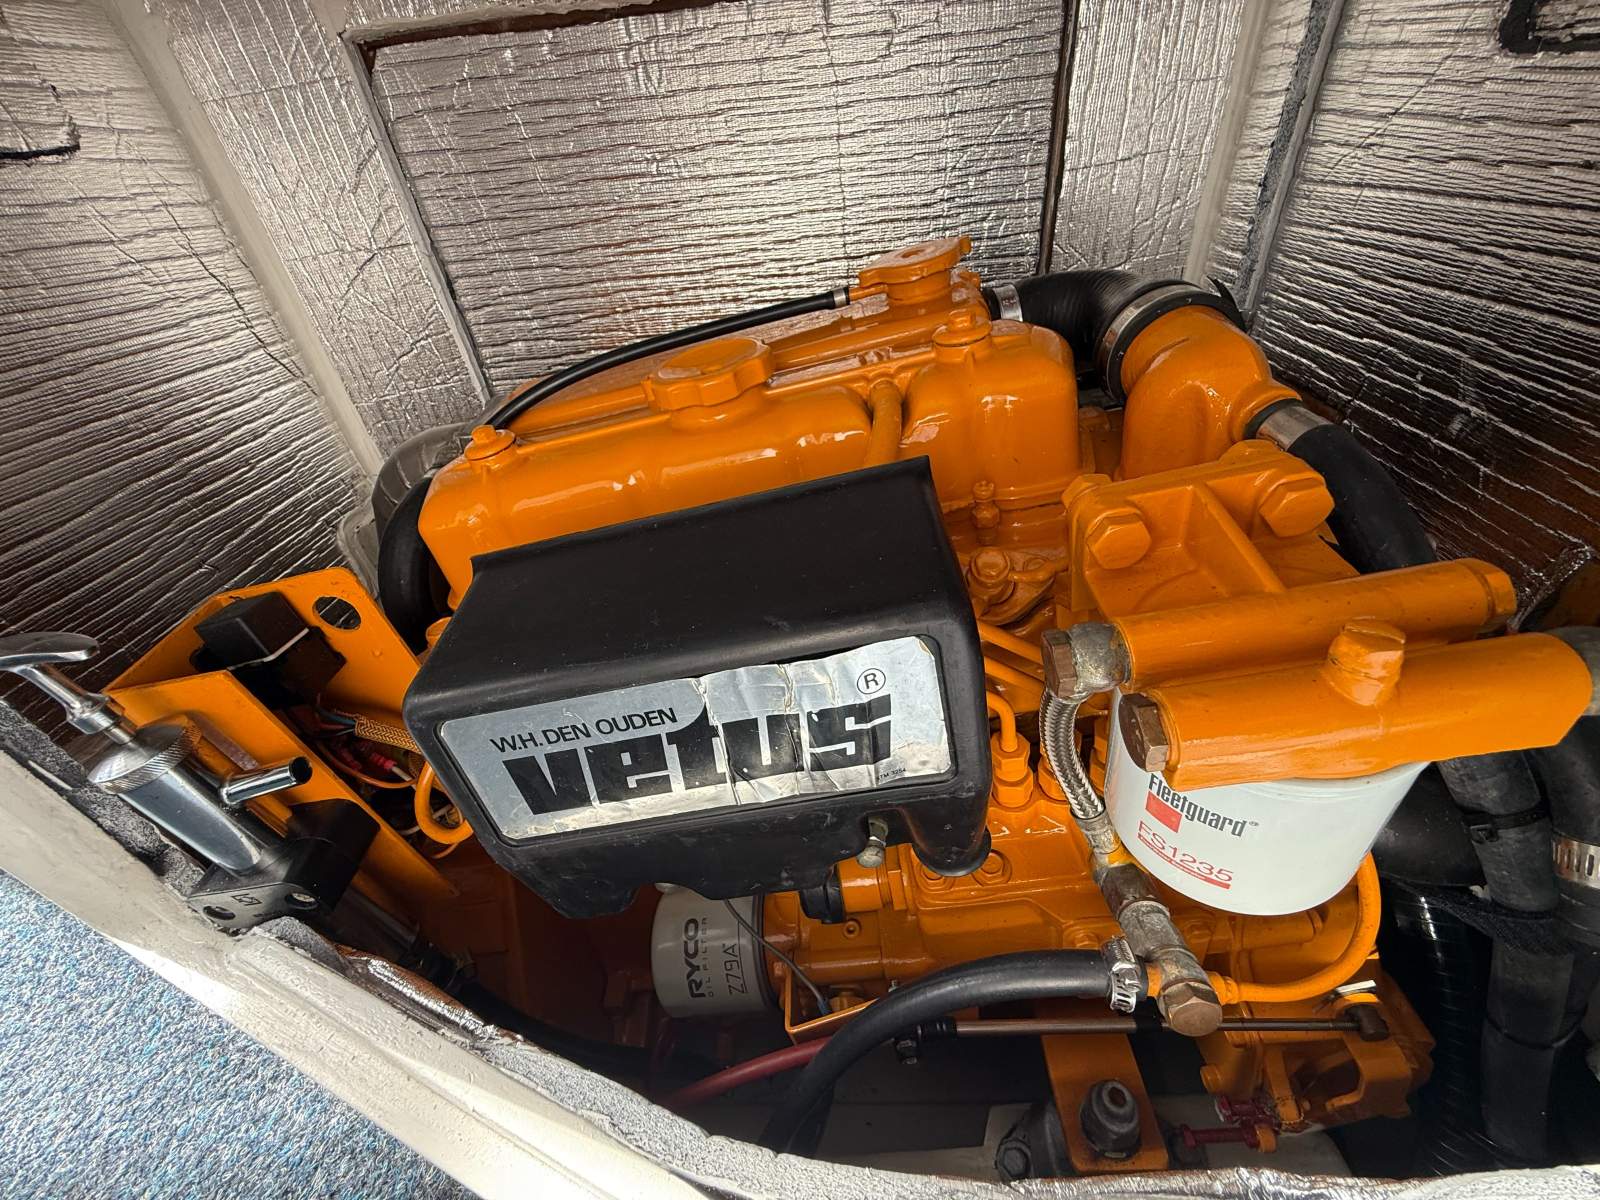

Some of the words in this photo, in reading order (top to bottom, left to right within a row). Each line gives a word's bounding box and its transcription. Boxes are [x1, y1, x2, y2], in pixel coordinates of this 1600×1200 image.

[541, 722, 592, 746] DEN
[595, 707, 678, 736] OUDEN
[1149, 772, 1248, 838] Fleetguard
[1137, 820, 1235, 883] FS1235
[683, 917, 707, 999] RYCO
[722, 943, 746, 995] Z79A
